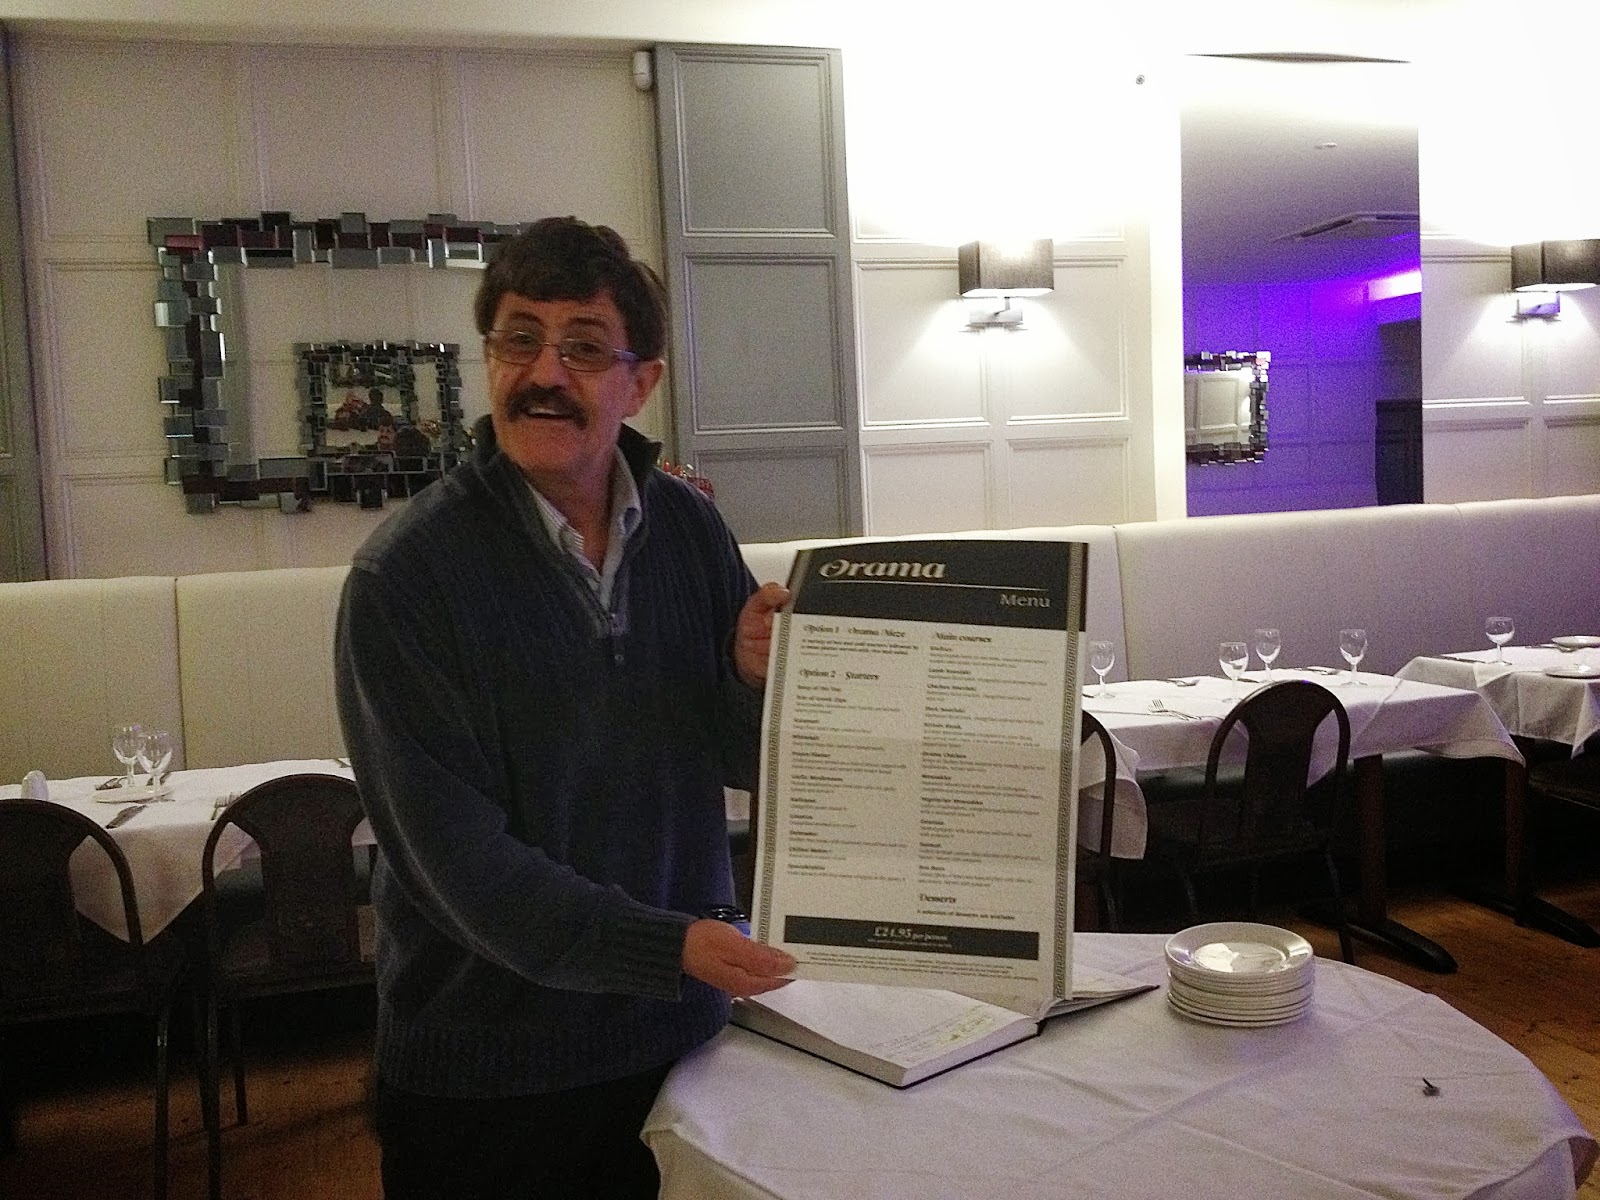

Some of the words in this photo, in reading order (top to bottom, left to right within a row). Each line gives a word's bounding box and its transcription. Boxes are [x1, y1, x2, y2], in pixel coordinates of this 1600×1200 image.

[819, 558, 947, 579] Orama
[999, 592, 1052, 609] Menu
[958, 634, 993, 643] courses
[845, 670, 881, 681] Starters
[919, 892, 957, 905] Desserts
